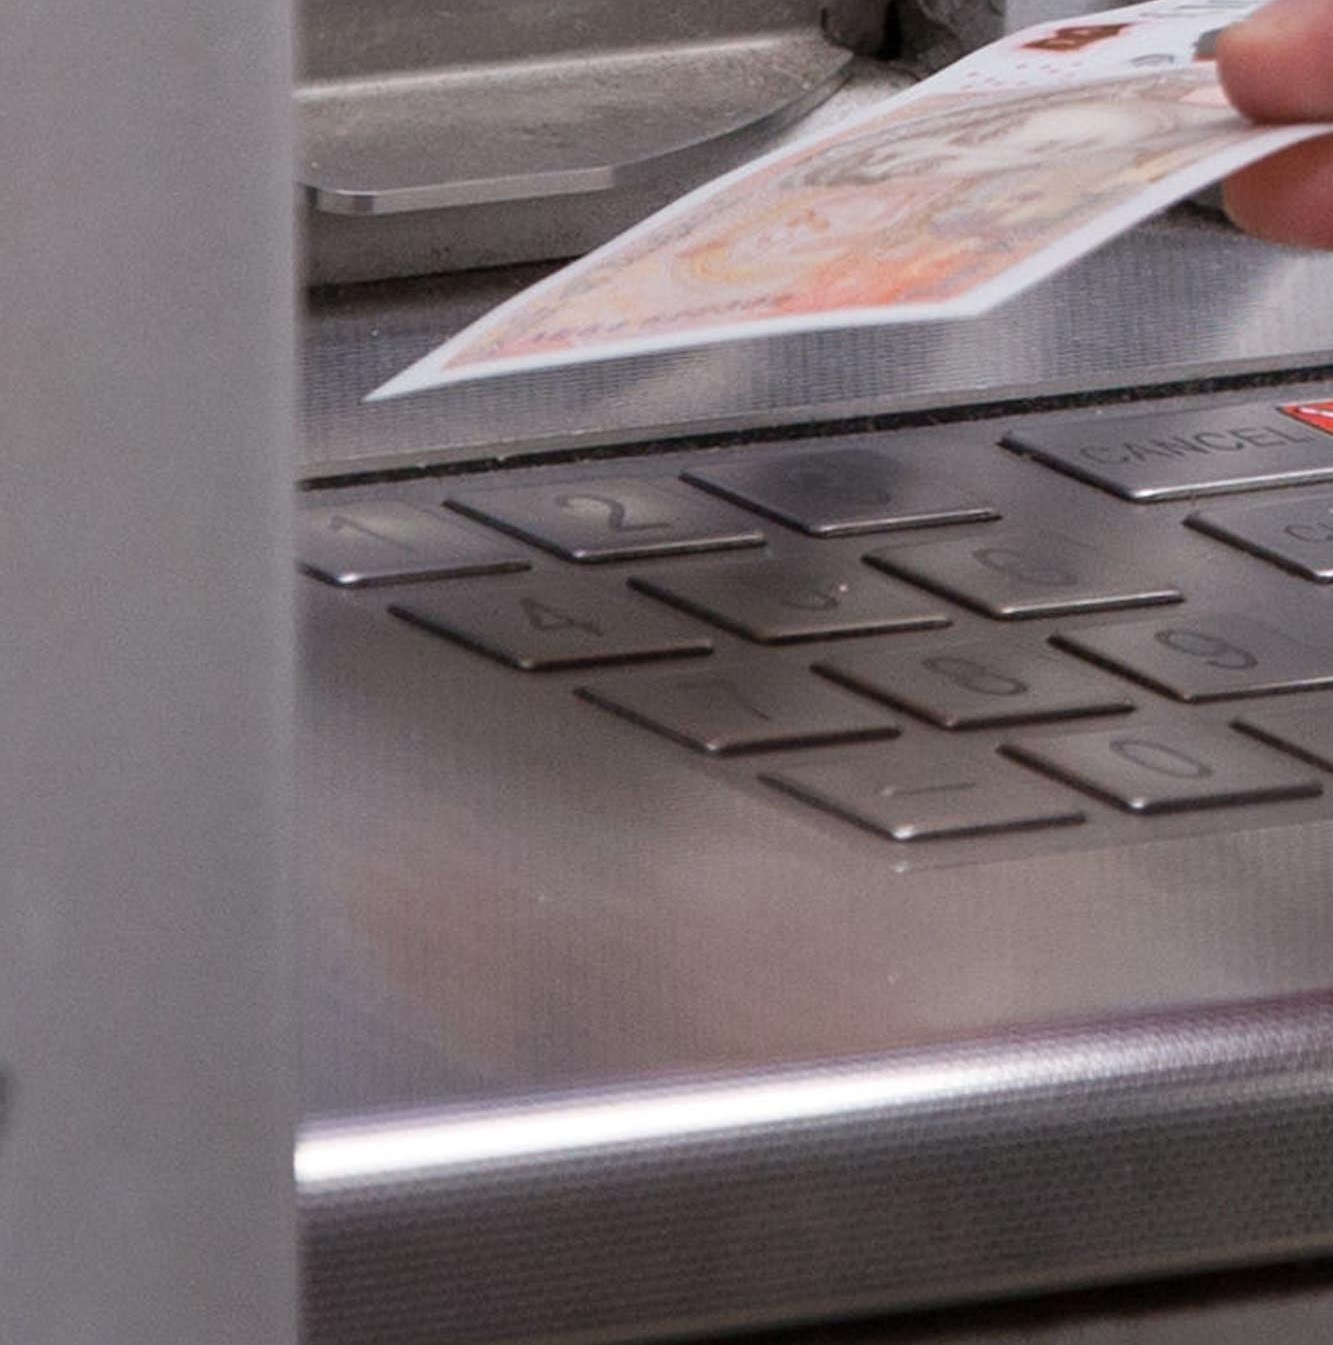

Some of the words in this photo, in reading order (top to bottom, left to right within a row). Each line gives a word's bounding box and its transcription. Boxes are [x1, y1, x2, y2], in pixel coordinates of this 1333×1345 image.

[1079, 423, 1316, 466] CANCEL
[554, 491, 671, 532] 2
[521, 595, 604, 637] 4
[1154, 626, 1260, 671] 9
[921, 654, 1030, 697] 8
